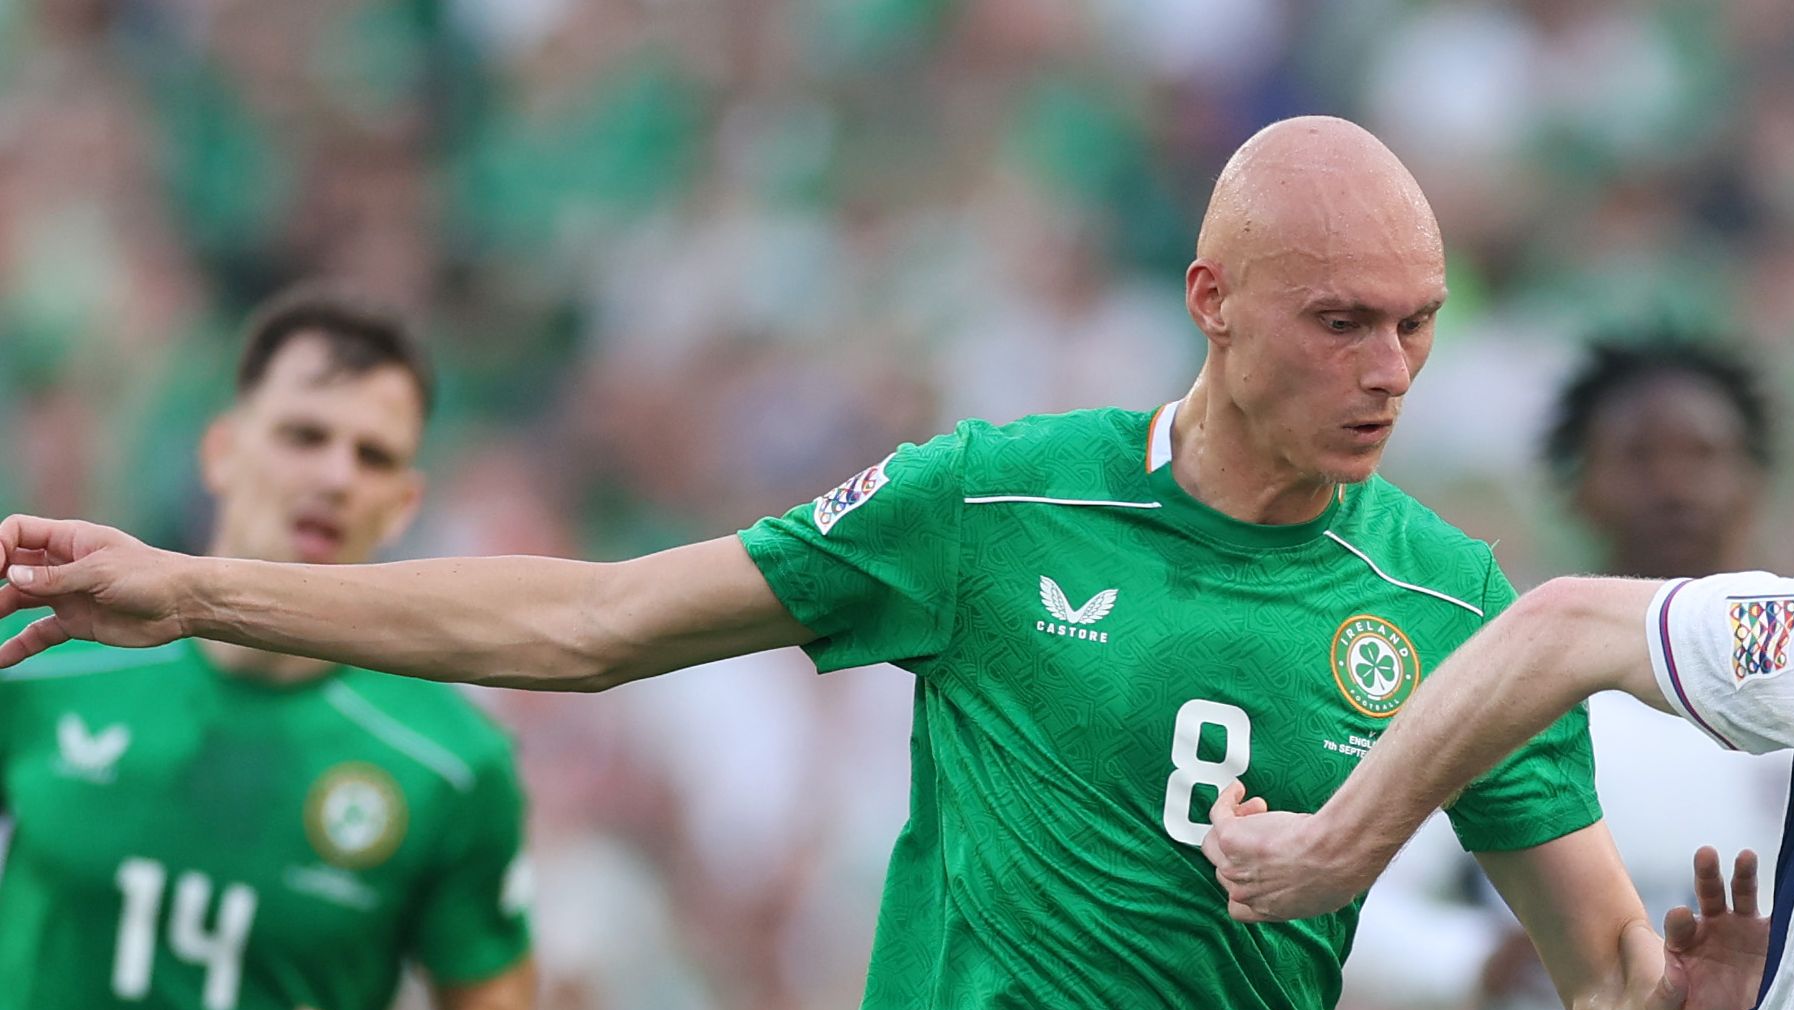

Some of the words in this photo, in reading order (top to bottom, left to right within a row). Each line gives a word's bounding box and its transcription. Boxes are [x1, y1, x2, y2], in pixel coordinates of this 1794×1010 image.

[1036, 620, 1109, 643] CASTORE
[1340, 621, 1409, 657] IRELAND
[1323, 739, 1337, 752] 7th
[1338, 743, 1368, 759] SEPTE
[1348, 735, 1377, 749] ENGL
[1163, 699, 1251, 846] 8
